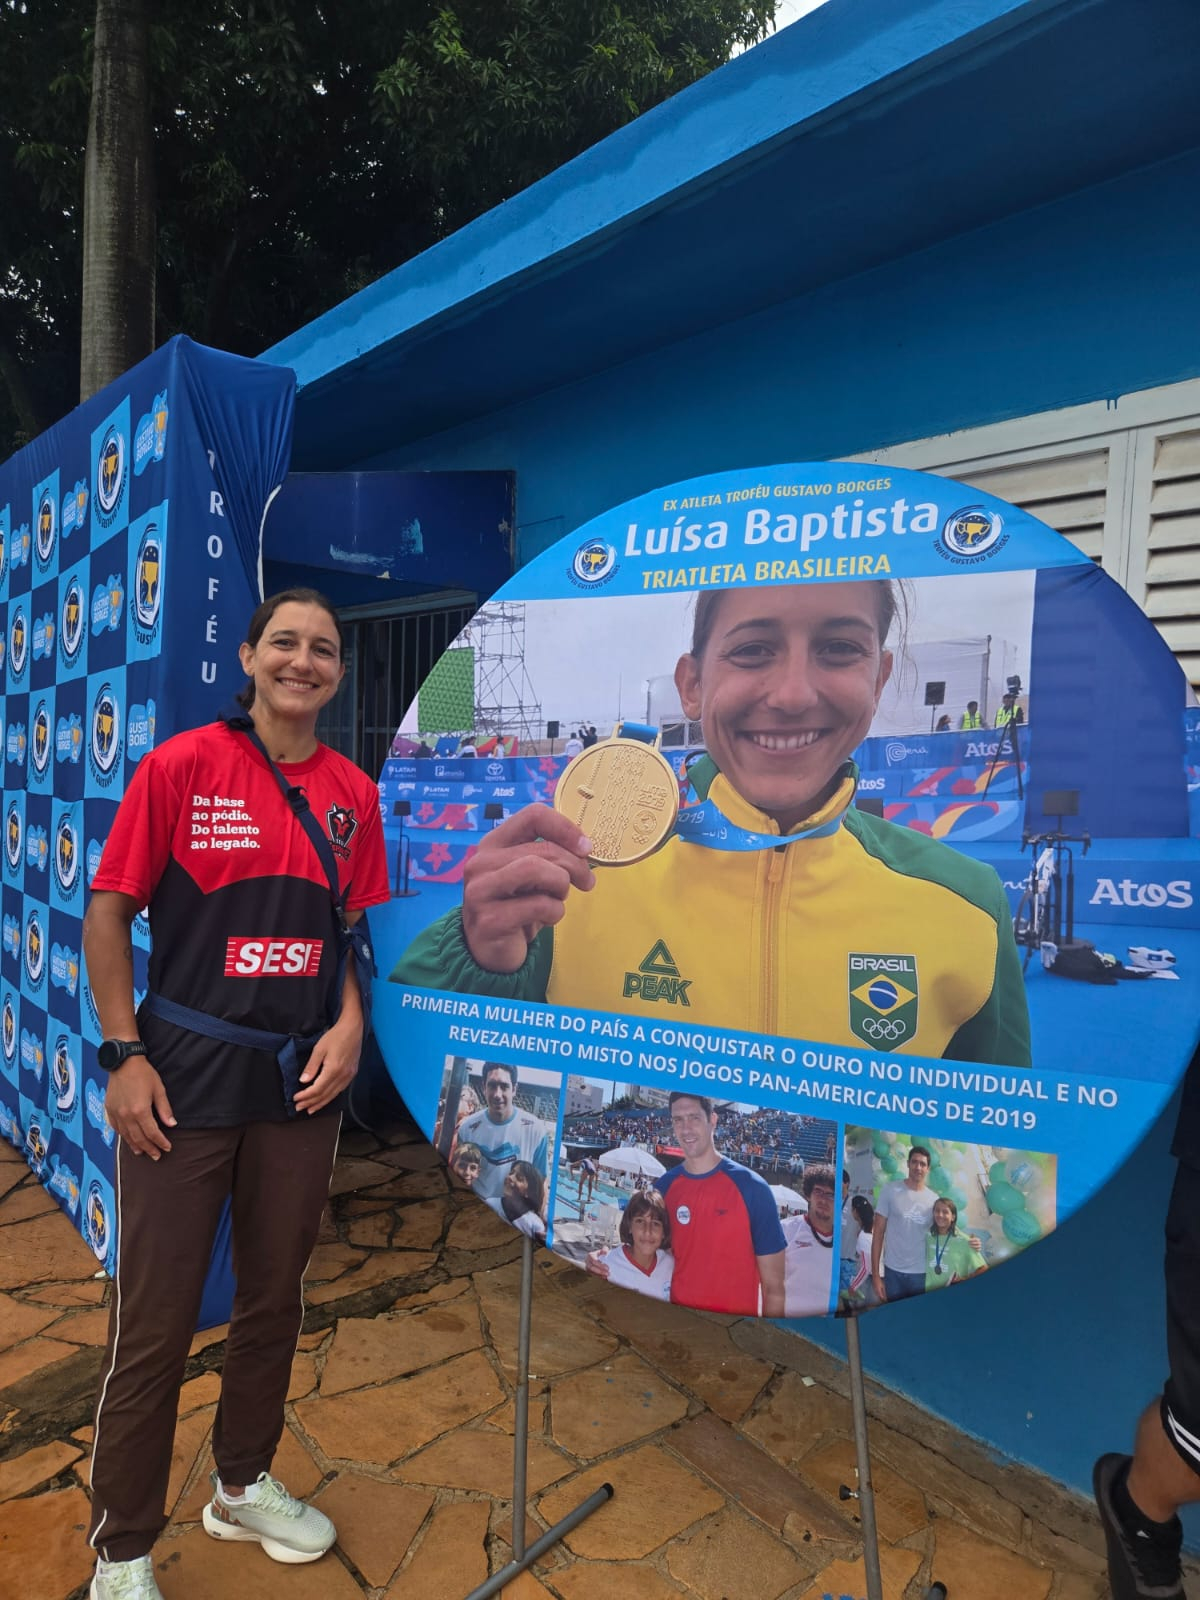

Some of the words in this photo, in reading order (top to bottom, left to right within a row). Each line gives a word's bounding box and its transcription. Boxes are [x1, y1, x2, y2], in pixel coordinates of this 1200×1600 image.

[663, 499, 681, 512] EX
[682, 494, 722, 510] ATLETA
[726, 486, 771, 504] TROFÉU
[773, 482, 833, 499] GUSTAVO
[836, 477, 891, 494] BORGES
[624, 516, 728, 557] Luísa
[744, 498, 938, 552] Baptista
[642, 563, 747, 590] TRIATLETA
[754, 553, 891, 582] BRASILEIRA
[192, 812, 208, 821] ao
[212, 810, 252, 823] pódio.
[193, 795, 210, 807] Da
[214, 796, 245, 808] base
[678, 811, 704, 824] 019
[191, 840, 208, 849] ao
[211, 838, 261, 851] legado.
[192, 824, 210, 835] Do
[213, 824, 260, 835] talento
[235, 942, 312, 974] SESI
[850, 957, 914, 972] BRASIL
[622, 971, 692, 1007] PEAK
[402, 993, 480, 1019] PRIMEIRA
[484, 1004, 555, 1029] MULHER
[560, 1015, 587, 1033] DO
[591, 1018, 629, 1040] PAÍS
[633, 1025, 646, 1042] A
[650, 1027, 775, 1061] CONQUISTAR
[781, 1048, 796, 1064] O
[802, 1050, 863, 1076] OURO
[870, 1062, 902, 1082] NO
[909, 1065, 1049, 1100] INDIVIDUAL
[1057, 1083, 1069, 1102] E
[1078, 1086, 1118, 1108] NO
[449, 1025, 573, 1057] REVEZAMENTO
[578, 1044, 633, 1067] MISTO
[639, 1052, 678, 1074] NOS
[679, 1059, 743, 1085] JOGOS
[749, 1071, 938, 1118] PAN-AMERICANOS
[945, 1102, 974, 1123] DE
[981, 1106, 1036, 1130] 2019
